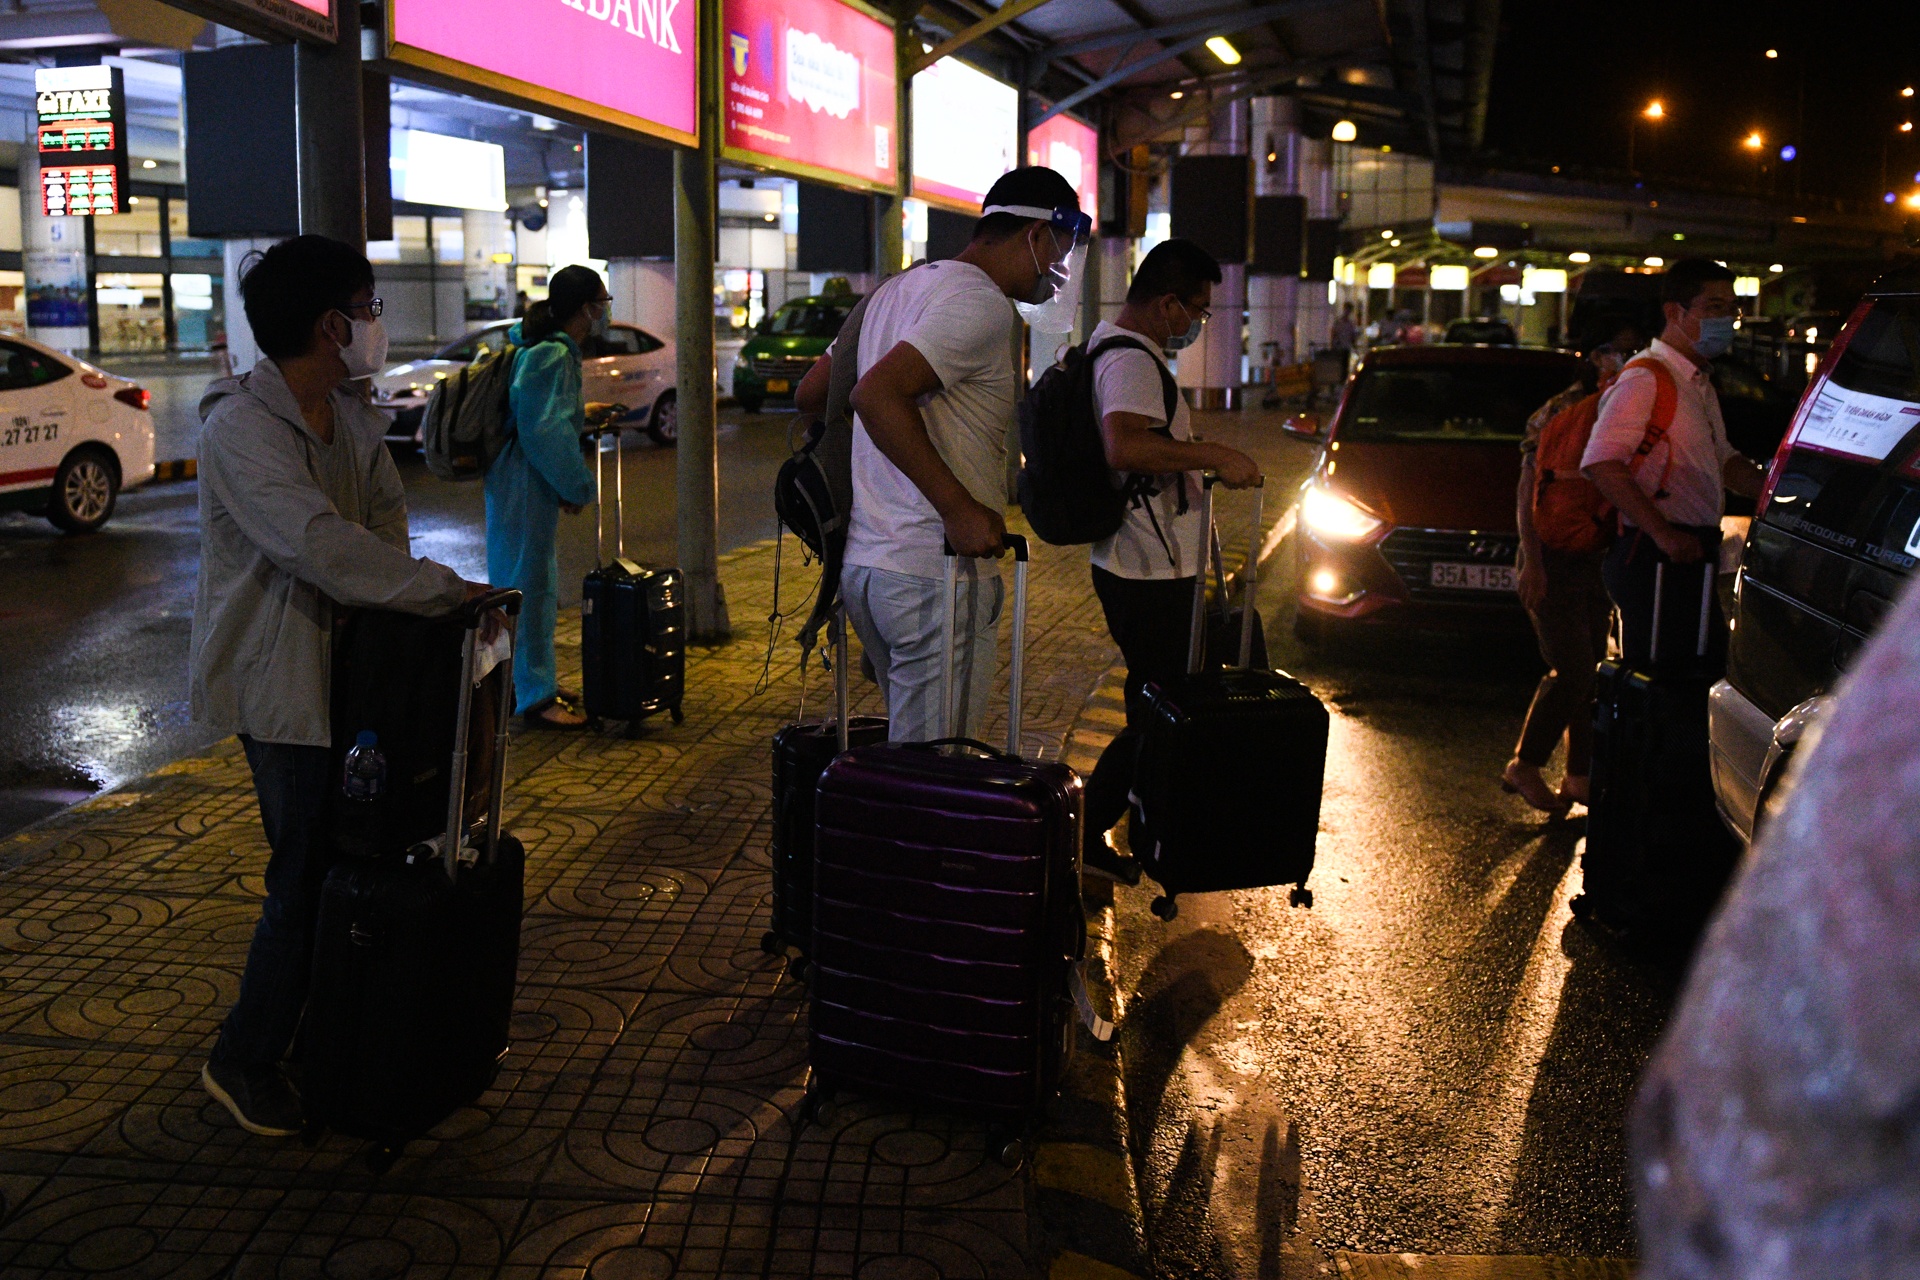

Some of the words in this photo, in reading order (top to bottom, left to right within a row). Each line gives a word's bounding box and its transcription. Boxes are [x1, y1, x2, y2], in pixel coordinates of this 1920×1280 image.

[24, 425, 39, 443] 27
[43, 423, 58, 441] 27
[1779, 512, 1857, 548] INTERCOOLER
[1864, 542, 1916, 568] TURBO
